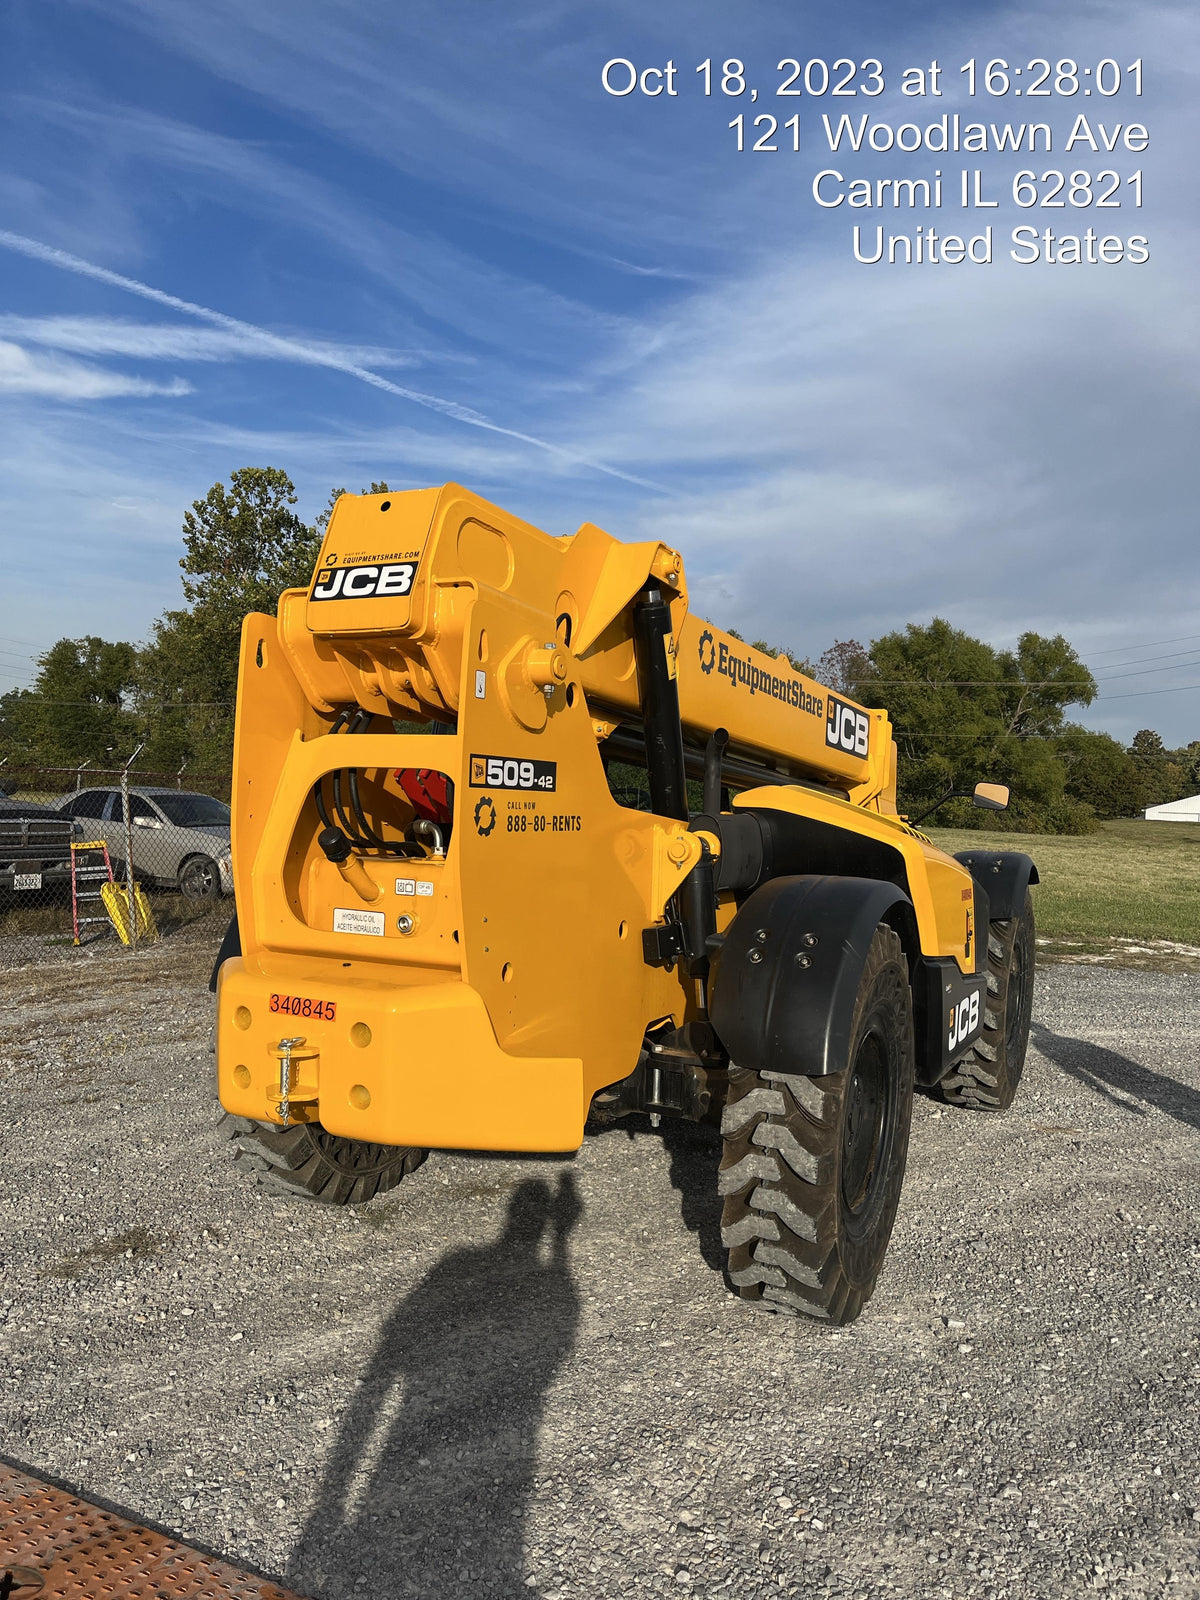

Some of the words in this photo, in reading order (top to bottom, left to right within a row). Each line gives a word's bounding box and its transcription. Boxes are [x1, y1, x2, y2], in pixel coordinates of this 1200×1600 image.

[342, 551, 420, 564] EQUIPMENTSHARE.COM
[314, 564, 414, 599] JCB
[717, 641, 823, 719] EquipmentShare
[827, 703, 869, 756] JCB
[507, 801, 522, 810] CALL
[506, 815, 582, 833] 888-80-RENTS
[342, 912, 368, 923] HYDRAULIC
[270, 993, 336, 1021] 340845
[948, 989, 980, 1051] JCB
